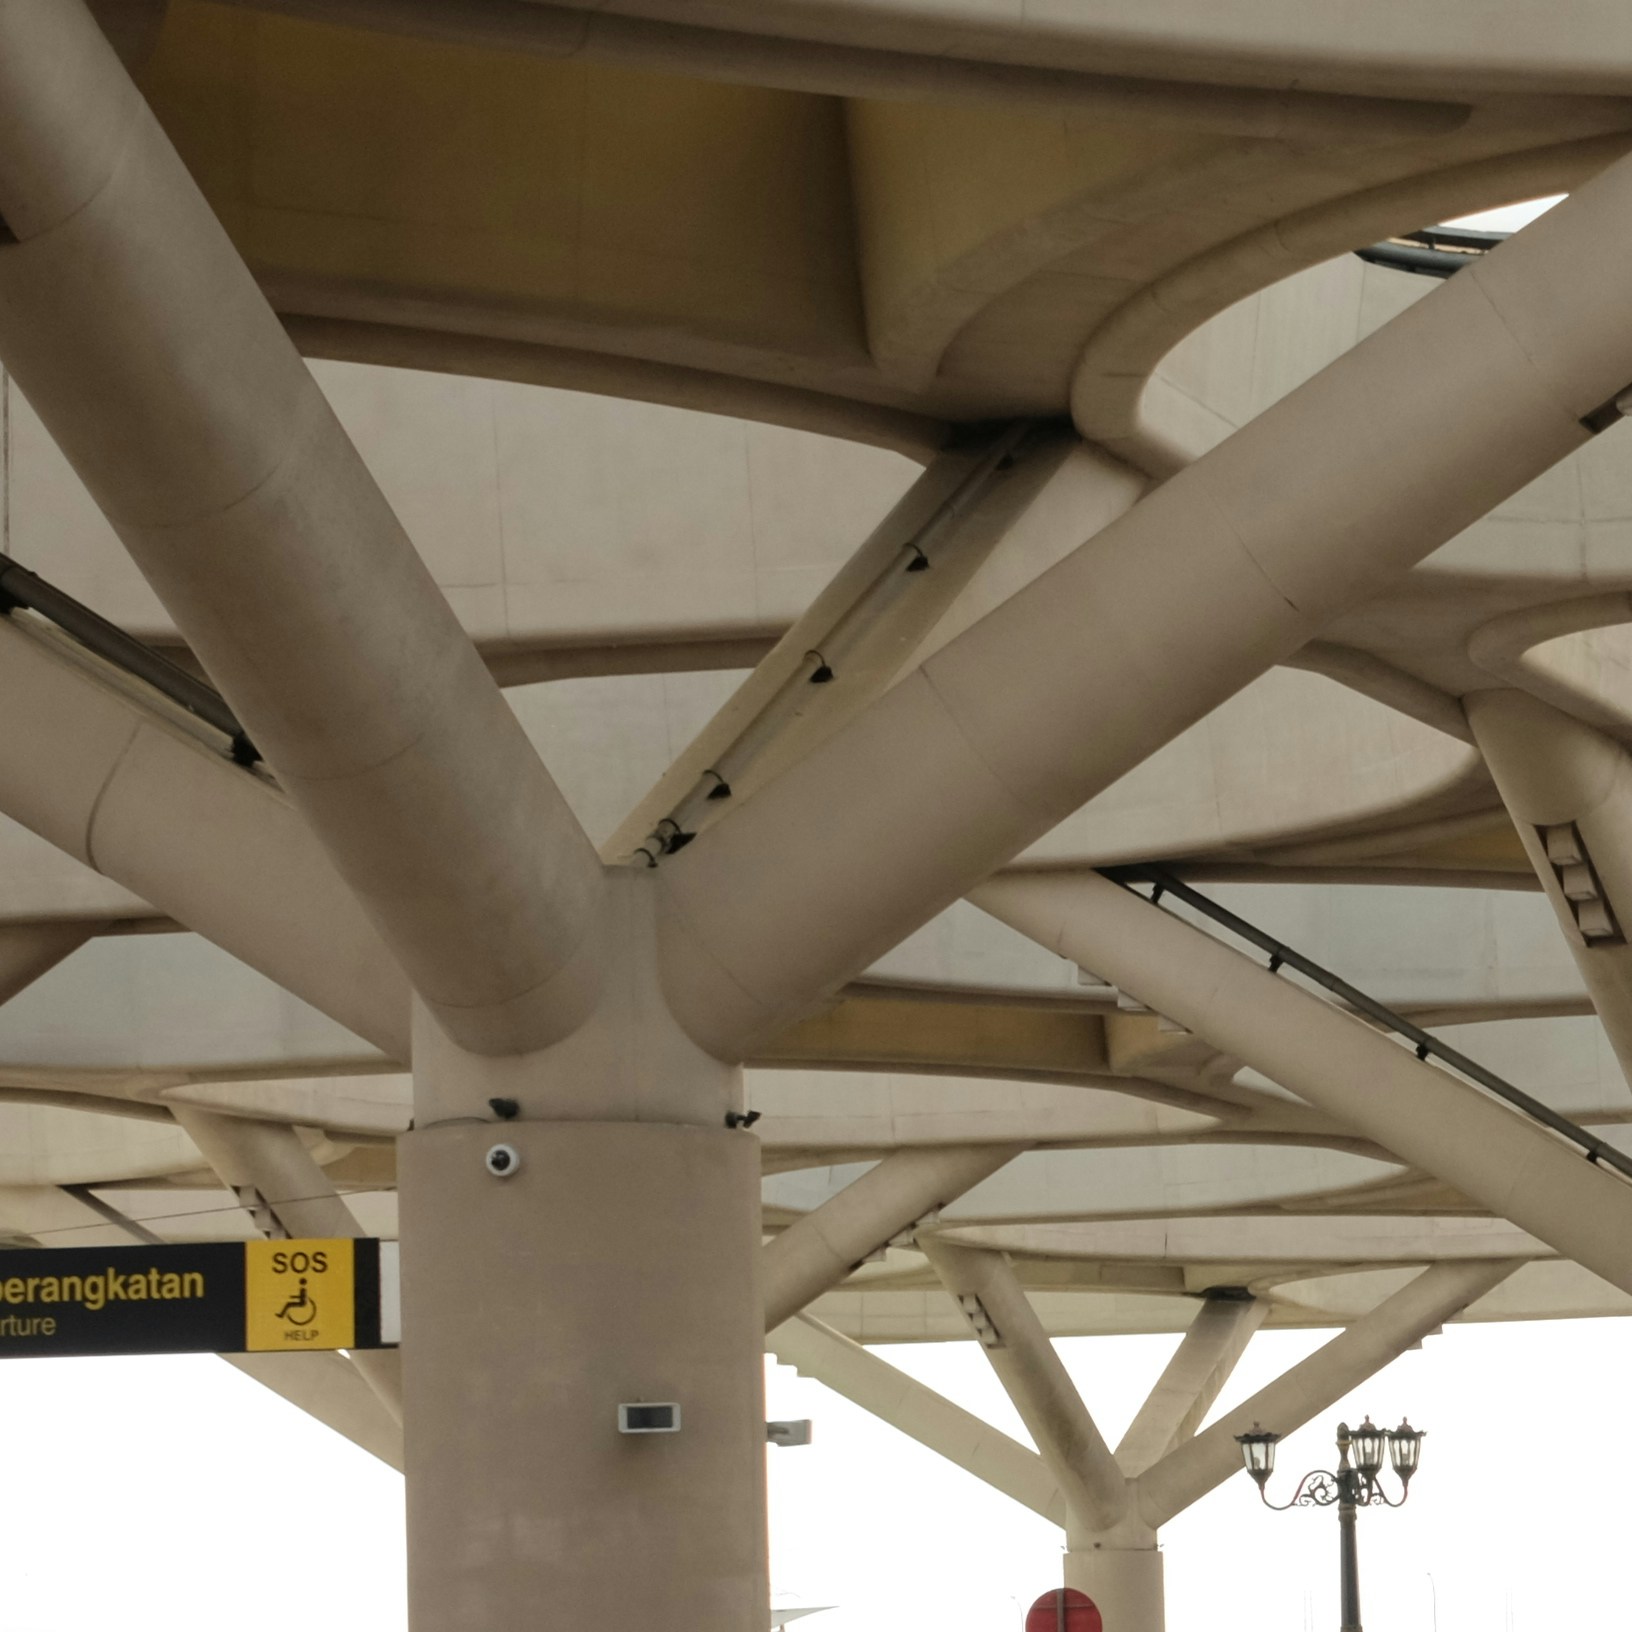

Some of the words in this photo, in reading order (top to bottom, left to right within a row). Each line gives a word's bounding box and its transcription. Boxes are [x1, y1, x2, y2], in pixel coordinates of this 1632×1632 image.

[271, 1251, 328, 1274] SOS
[0, 1266, 205, 1310] erangkatan
[283, 1329, 320, 1342] HELP
